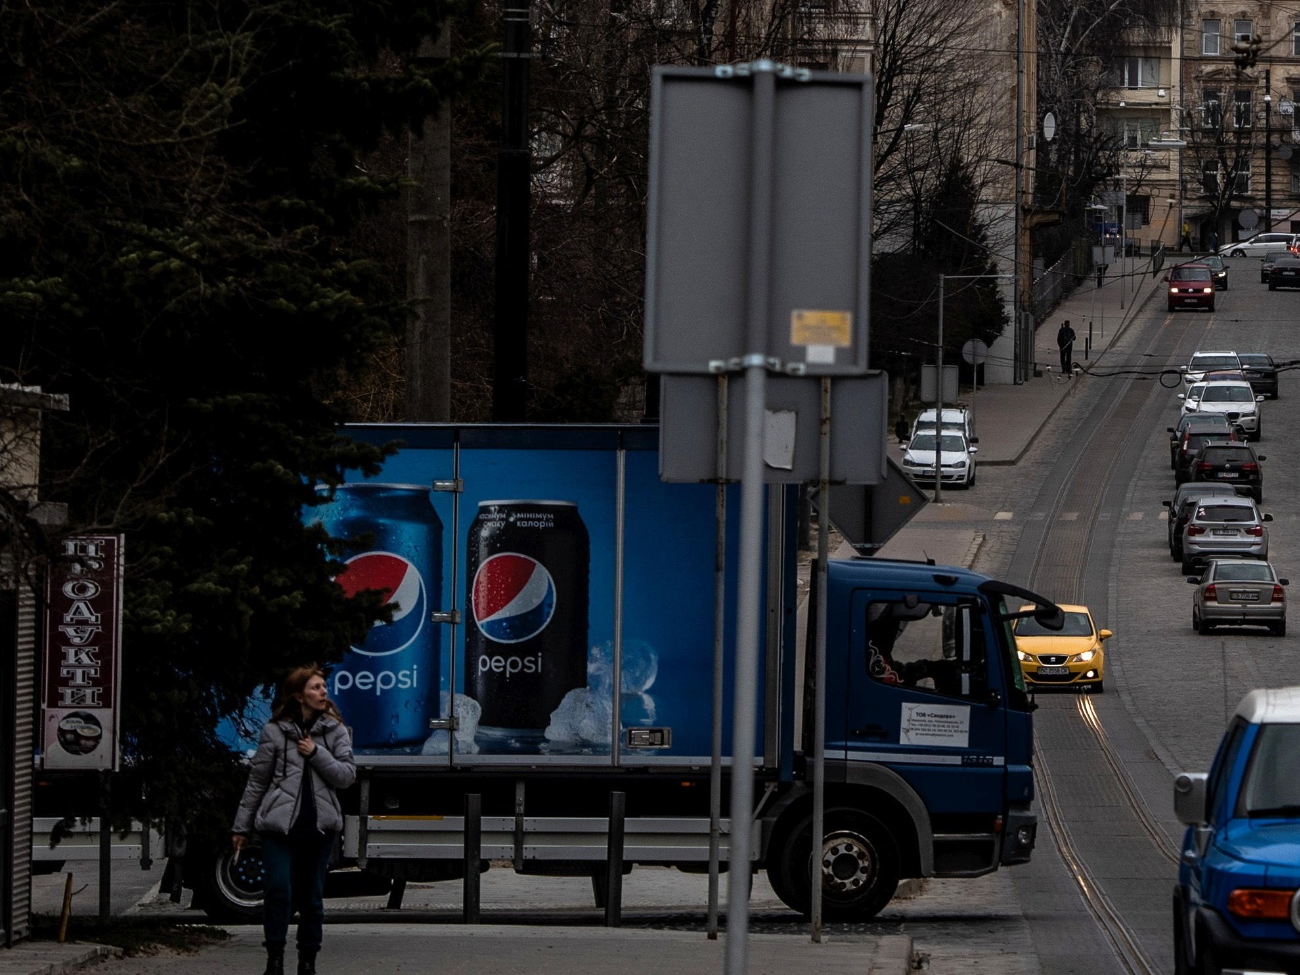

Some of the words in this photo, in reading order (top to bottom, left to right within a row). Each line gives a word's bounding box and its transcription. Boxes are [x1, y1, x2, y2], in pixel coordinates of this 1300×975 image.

[517, 512, 554, 521] мінімум
[517, 520, 554, 530] калорій
[478, 651, 542, 678] pepsi
[334, 664, 418, 696] pepsi
